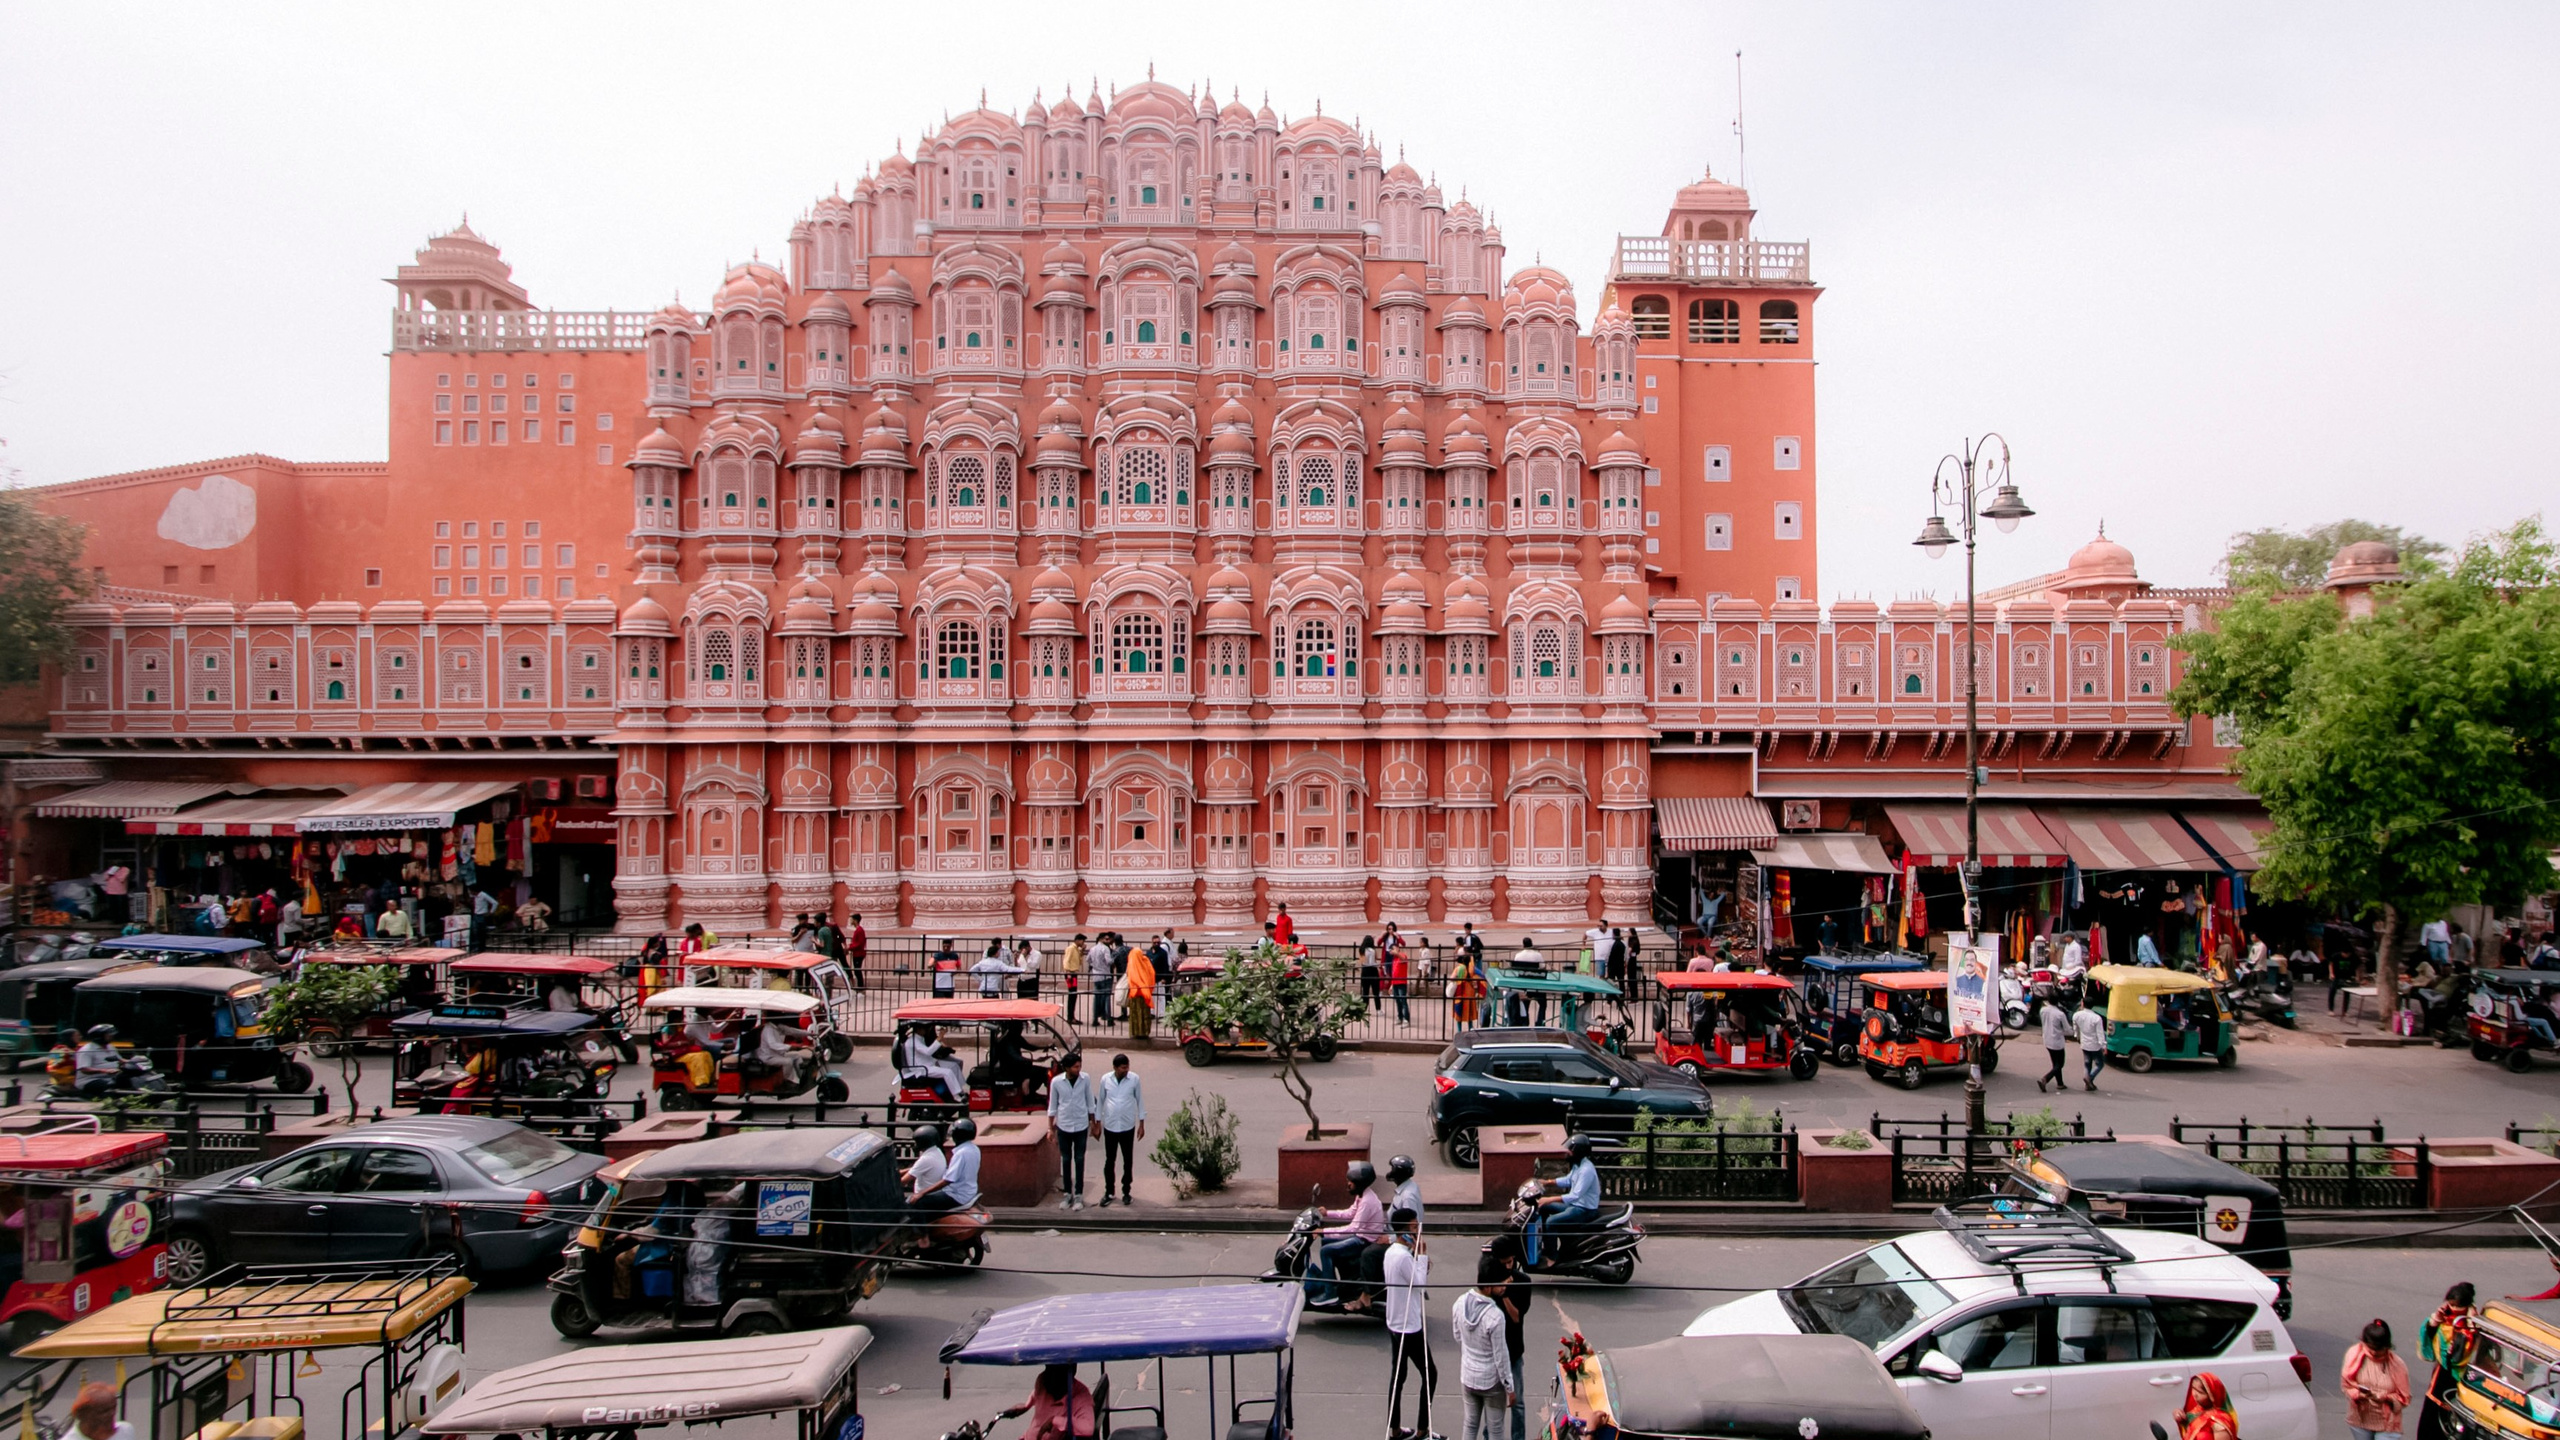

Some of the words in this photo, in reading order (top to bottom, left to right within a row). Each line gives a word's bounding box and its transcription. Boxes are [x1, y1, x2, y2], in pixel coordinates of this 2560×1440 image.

[309, 819, 373, 829] WHOLESALER
[379, 817, 441, 827] EXPORTER
[414, 1290, 455, 1325] Panther
[199, 1332, 321, 1350] Panther
[582, 1402, 720, 1423] Panther
